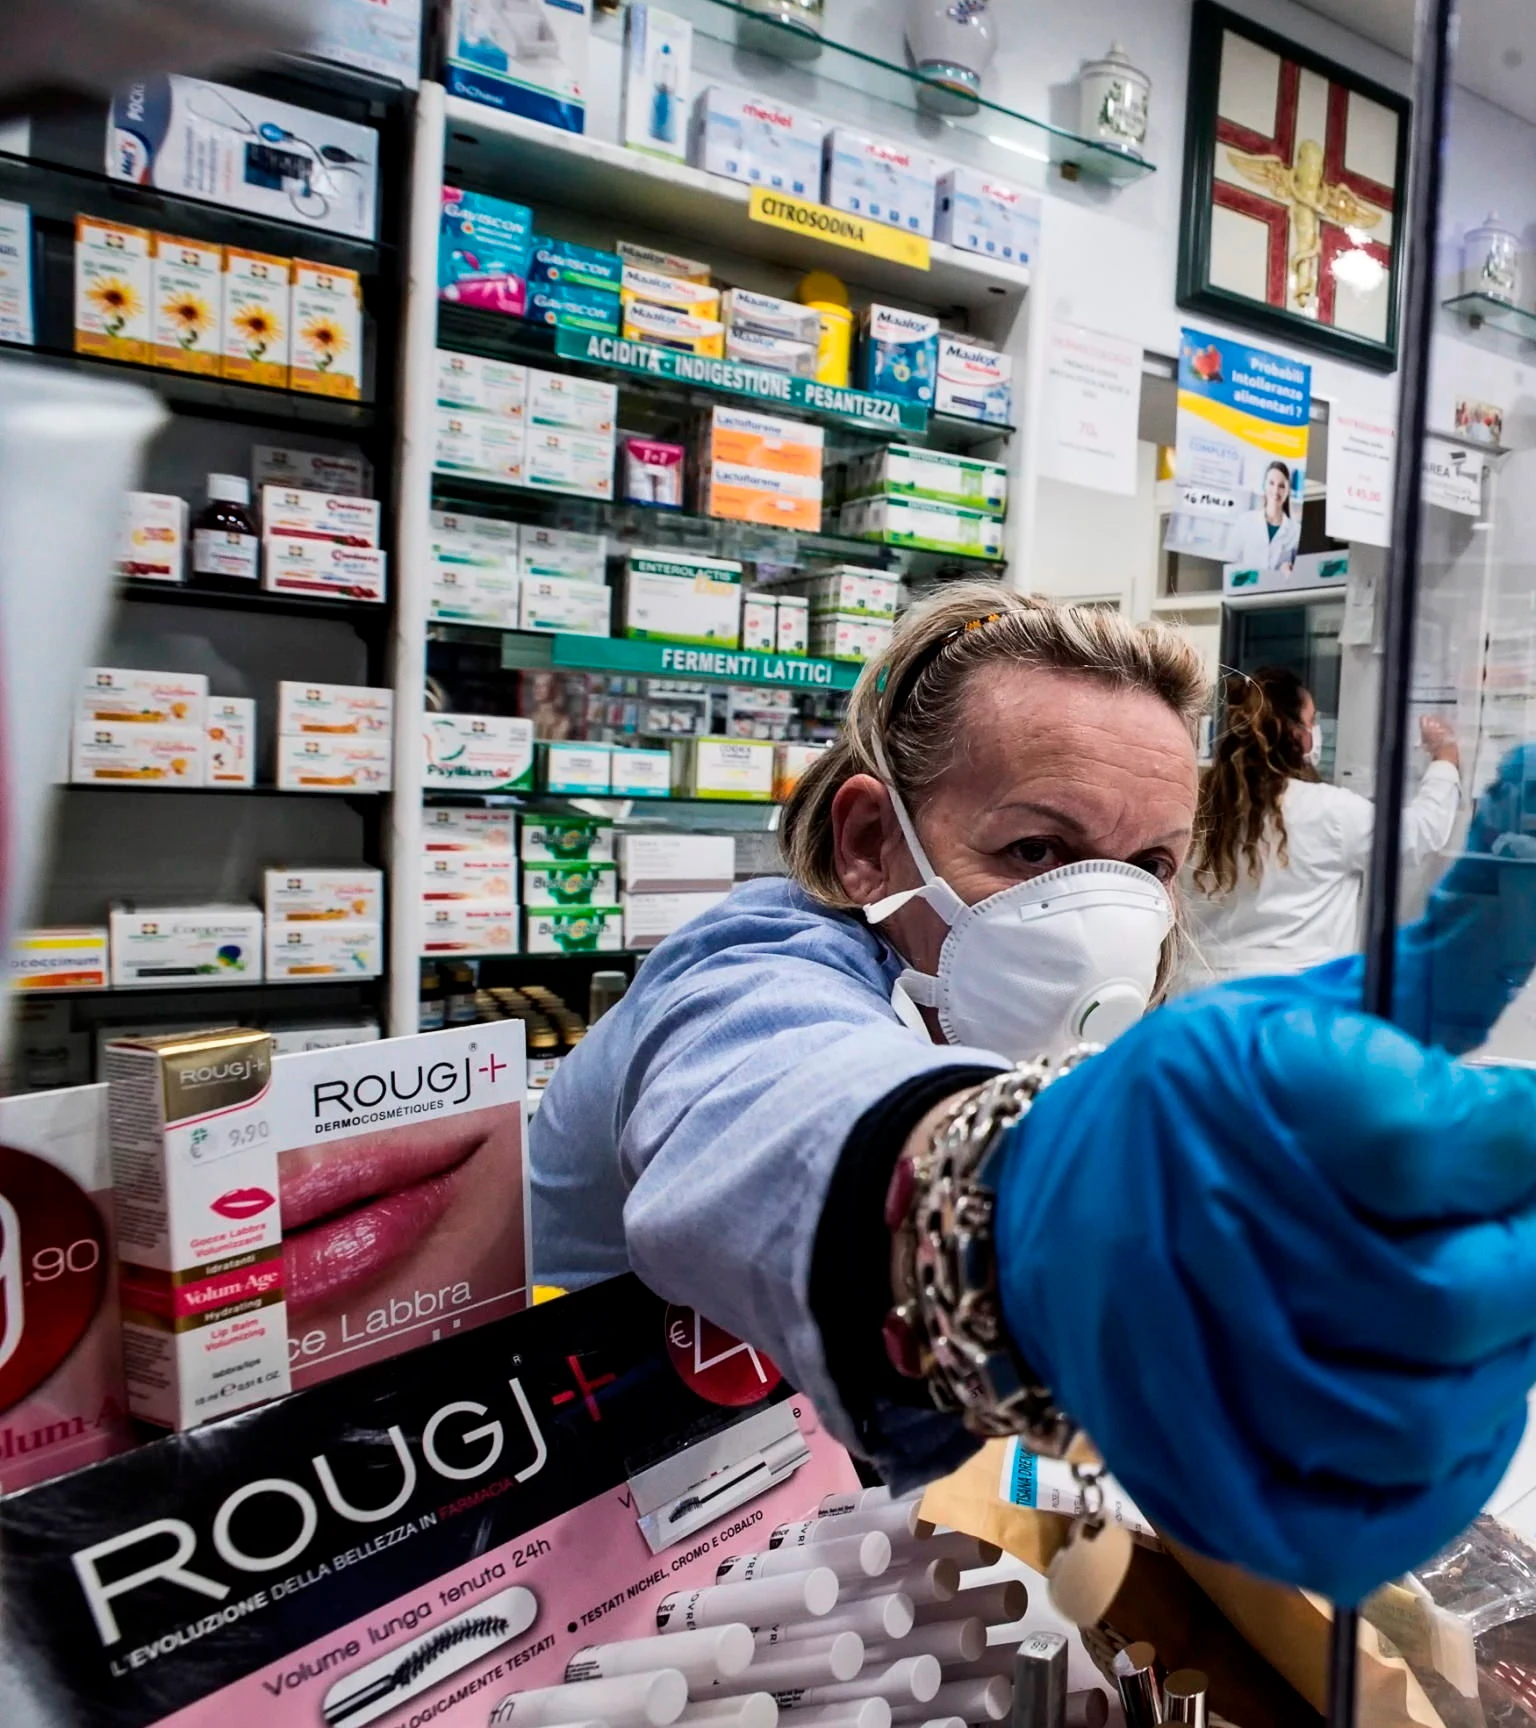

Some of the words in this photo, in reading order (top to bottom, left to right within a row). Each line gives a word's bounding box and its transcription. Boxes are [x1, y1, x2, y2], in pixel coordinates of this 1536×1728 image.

[742, 103, 793, 128] medel
[761, 196, 866, 242] CITROSODINA
[876, 310, 930, 333] Maalox
[945, 344, 1000, 367] Maalox
[1250, 356, 1304, 385] Probabili
[675, 358, 792, 402] INDIGESTIONE
[805, 384, 901, 423] PESANTEZZA
[1232, 369, 1303, 401] Intolleranze
[638, 560, 733, 582] ENTEROLACTIS
[662, 648, 757, 678] FERMENTI
[763, 658, 832, 684] LATTICI
[315, 1099, 444, 1134] DERMOCOSMÉTIQUES
[340, 1278, 472, 1345] Labbra
[669, 1319, 693, 1349] €
[1015, 1475, 1035, 1507] TISANA
[110, 1590, 269, 1678] L'EVOLUZIONE
[270, 1563, 332, 1603] DELLA
[332, 1523, 419, 1570] BELLEZZA
[418, 1510, 439, 1533] IN
[437, 1477, 515, 1523] FARMACIA
[580, 1594, 626, 1628] TESTATI
[671, 1545, 711, 1573] CROMO
[720, 1509, 764, 1542] COBALTO
[262, 1637, 361, 1698] Volume
[366, 1601, 433, 1648] lunga
[439, 1563, 506, 1604] tenuta
[512, 1536, 551, 1569] 24h
[394, 1664, 505, 1728] LOGICAMENTE
[505, 1634, 556, 1673] TESTATI
